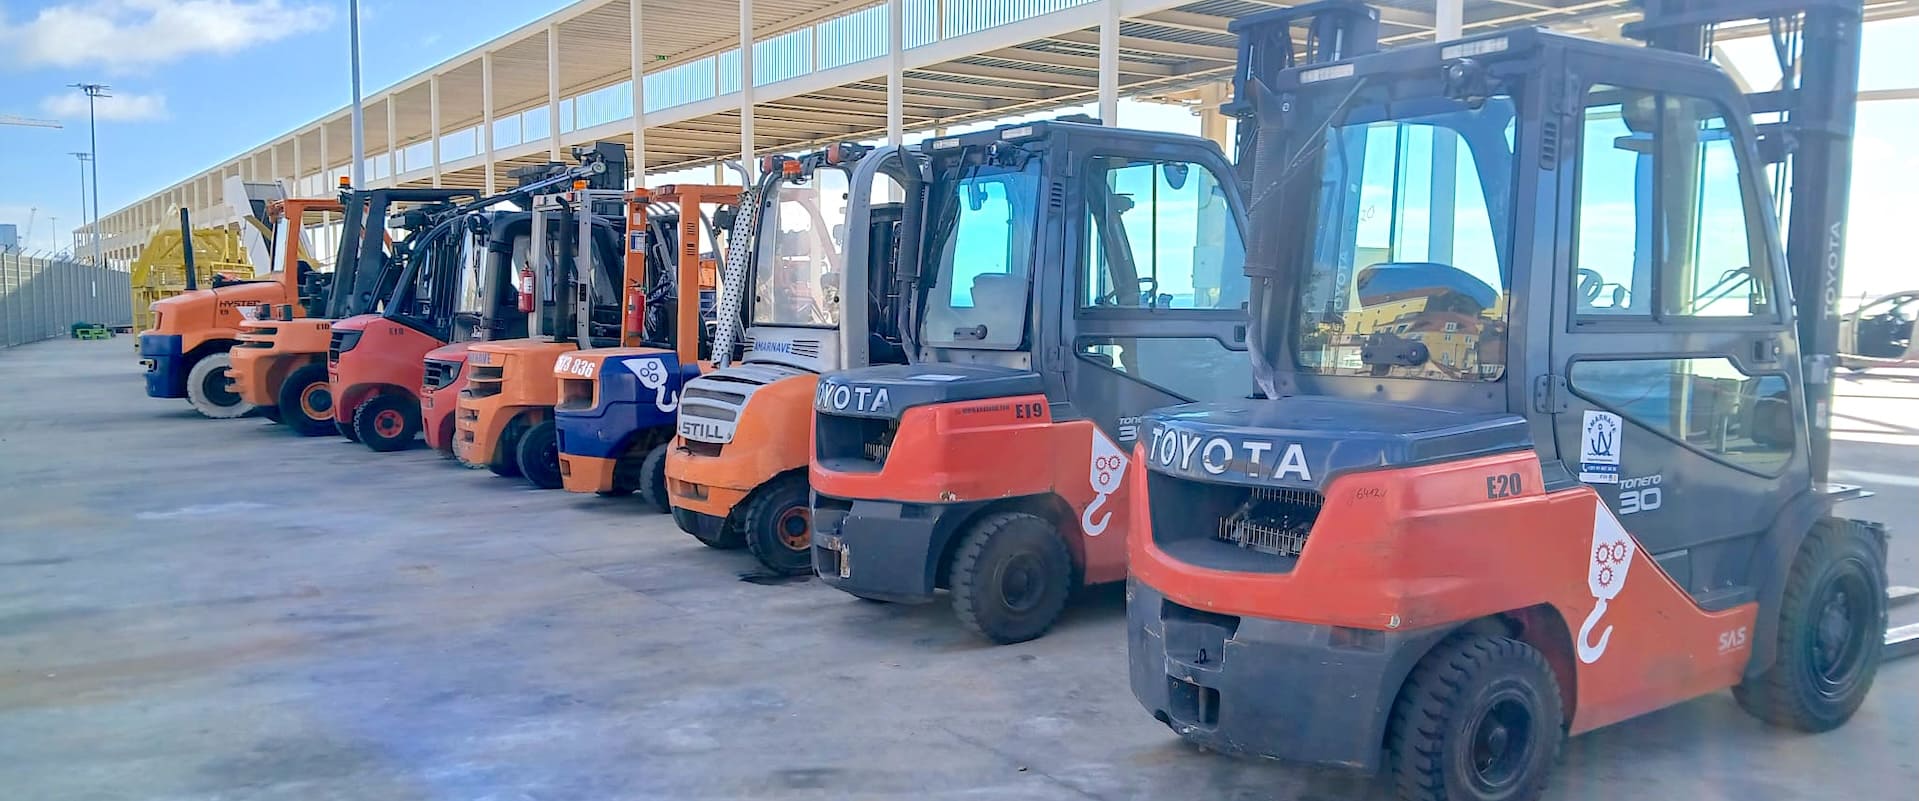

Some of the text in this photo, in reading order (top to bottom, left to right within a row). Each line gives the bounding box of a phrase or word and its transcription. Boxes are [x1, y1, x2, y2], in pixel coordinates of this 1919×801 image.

[1824, 221, 1841, 320] TOYOTA
[753, 340, 791, 354] AMARNAVE
[816, 380, 893, 413] OYOTA
[1015, 403, 1042, 419] E19
[682, 421, 723, 439] STILL
[1150, 426, 1313, 482] TOYOTA
[1486, 472, 1522, 499] E20
[1619, 474, 1662, 490] TONERO
[1618, 487, 1662, 515] 30
[1718, 625, 1746, 651] SAS
